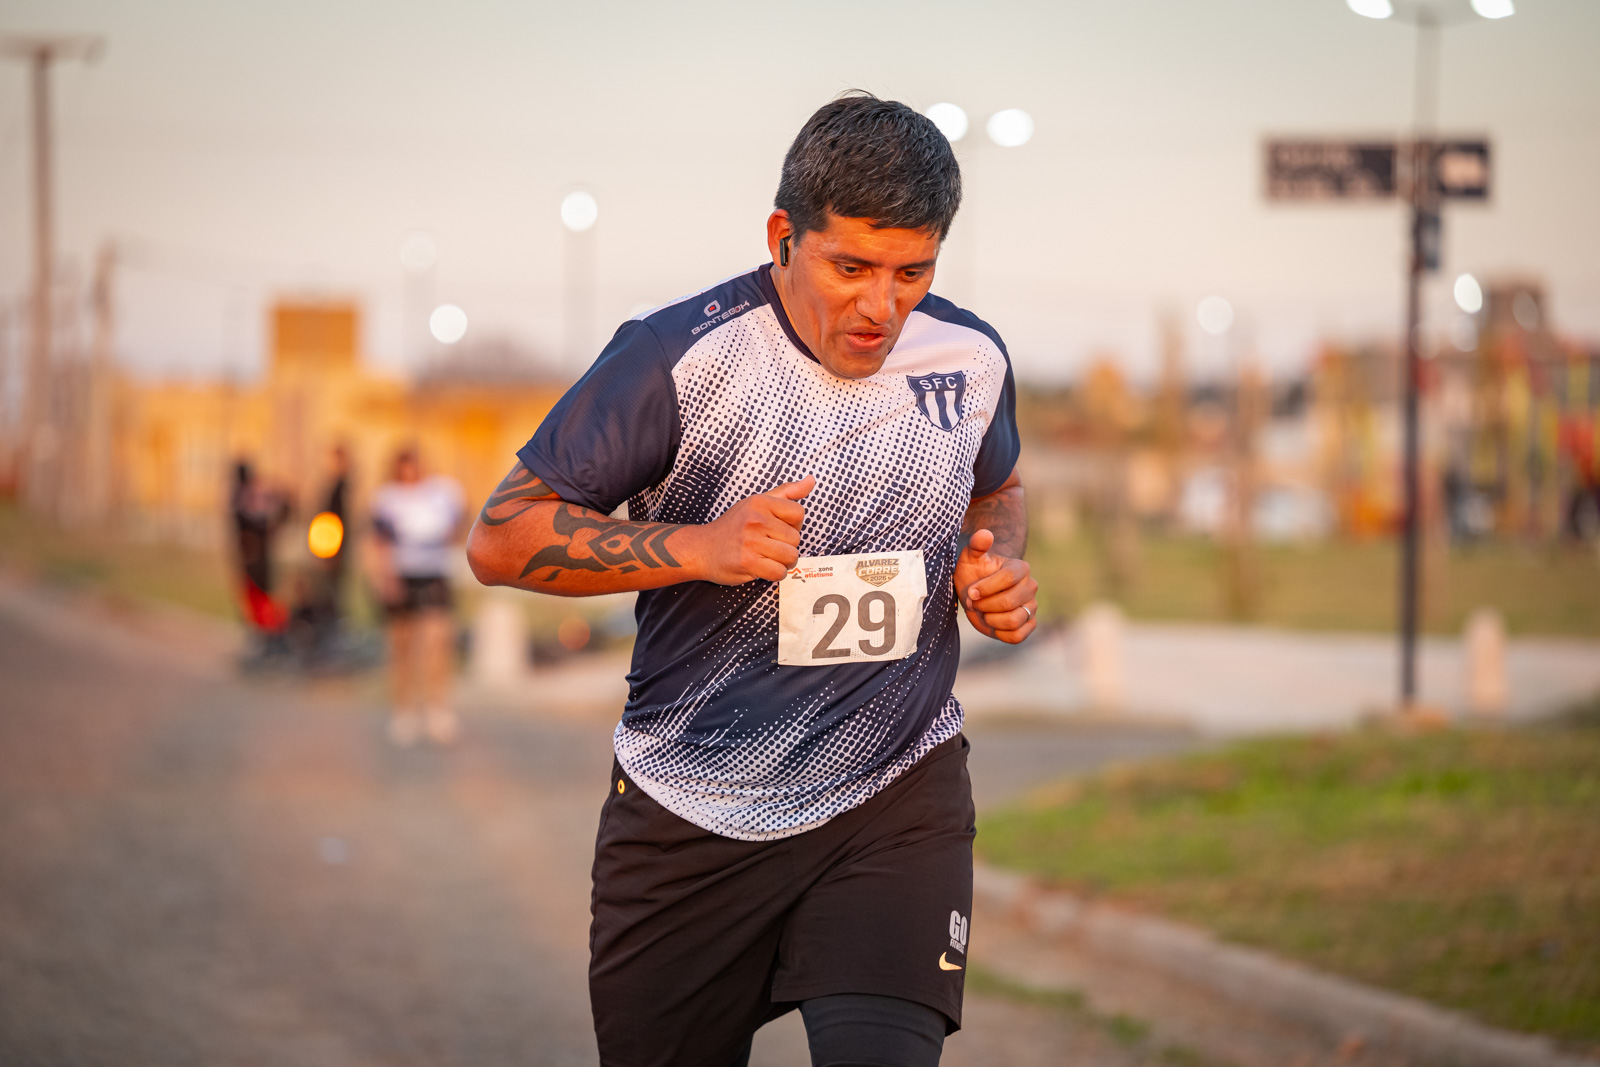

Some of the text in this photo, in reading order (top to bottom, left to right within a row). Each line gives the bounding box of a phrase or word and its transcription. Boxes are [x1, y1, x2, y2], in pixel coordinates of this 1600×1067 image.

[919, 376, 957, 390] SFC
[856, 558, 899, 569] ALVAREZ
[858, 566, 899, 576] CORRE
[811, 590, 896, 660] 29
[949, 910, 968, 946] GO
